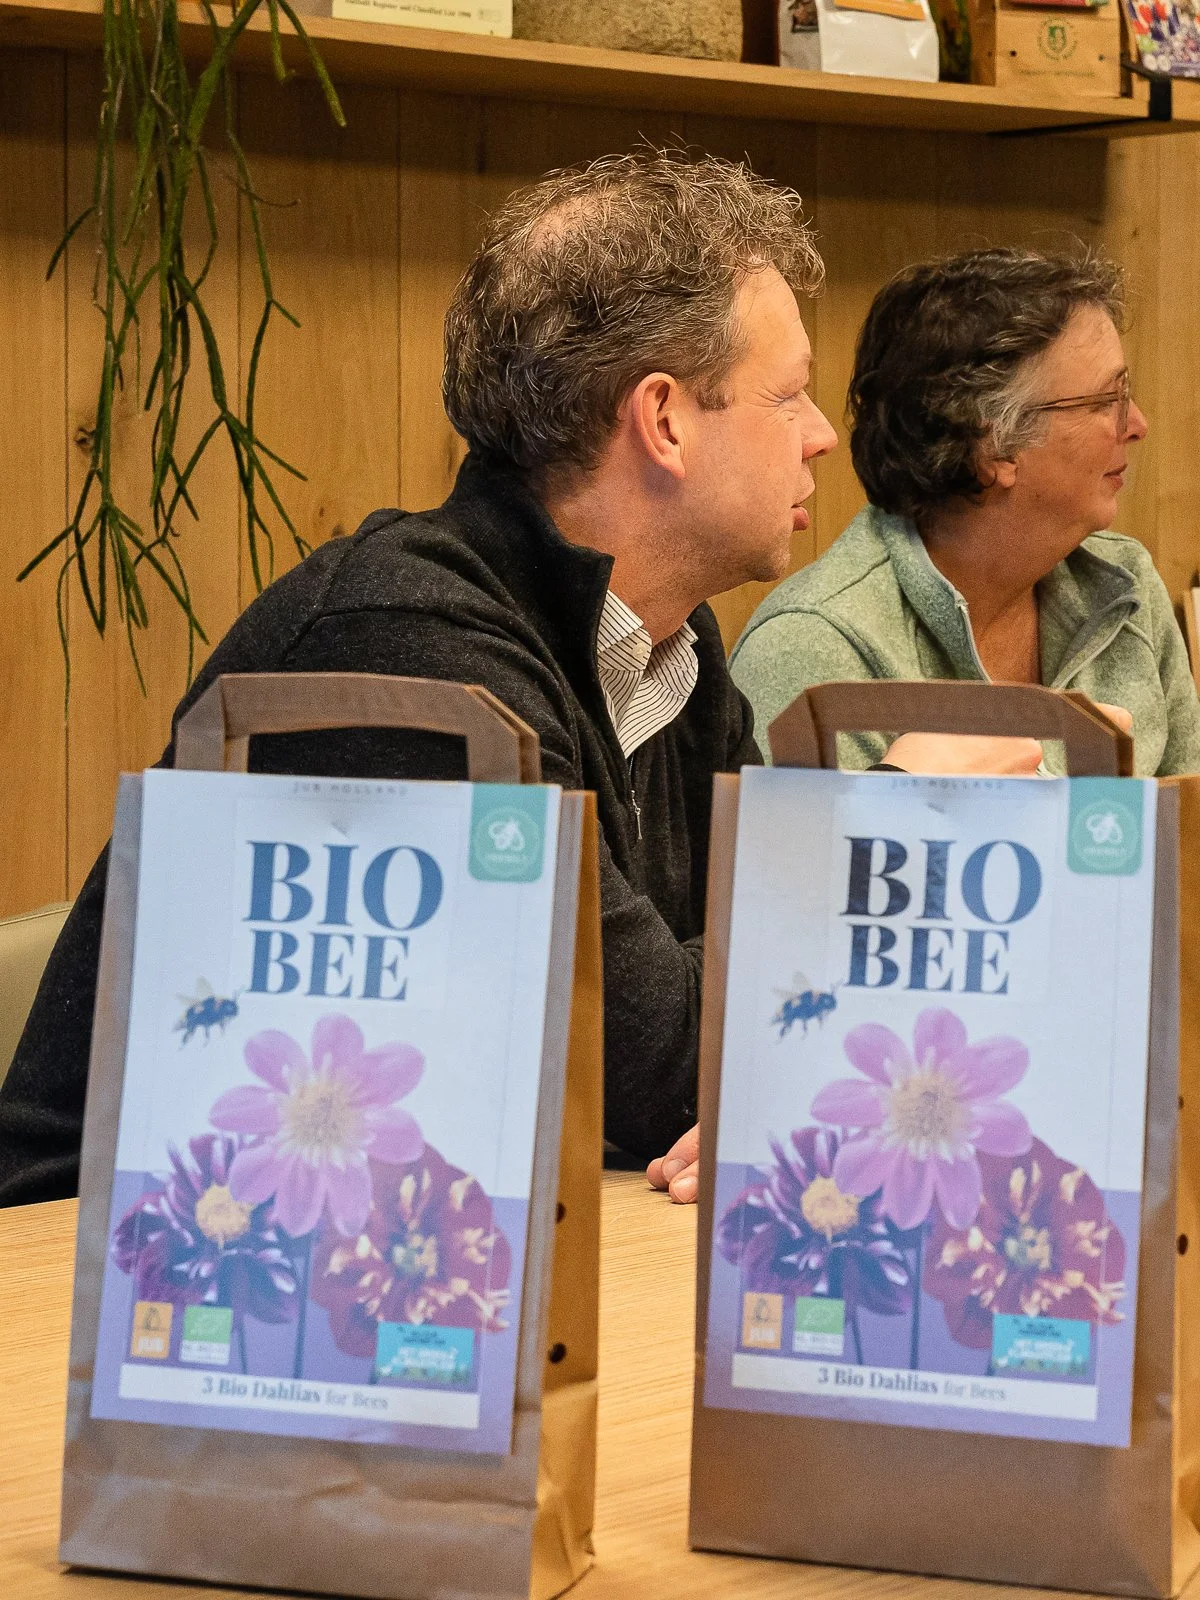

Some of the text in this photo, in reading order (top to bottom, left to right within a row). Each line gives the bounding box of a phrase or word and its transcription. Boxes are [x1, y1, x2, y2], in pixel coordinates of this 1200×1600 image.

[241, 839, 445, 932] BIO
[838, 836, 1042, 925] BIO
[245, 928, 410, 1001] BEE
[844, 922, 1010, 995] BEE
[202, 1376, 388, 1410] 3 Bio Dahlias for Bees
[817, 1367, 1006, 1401] 3 Bio Dahlias for Bees
